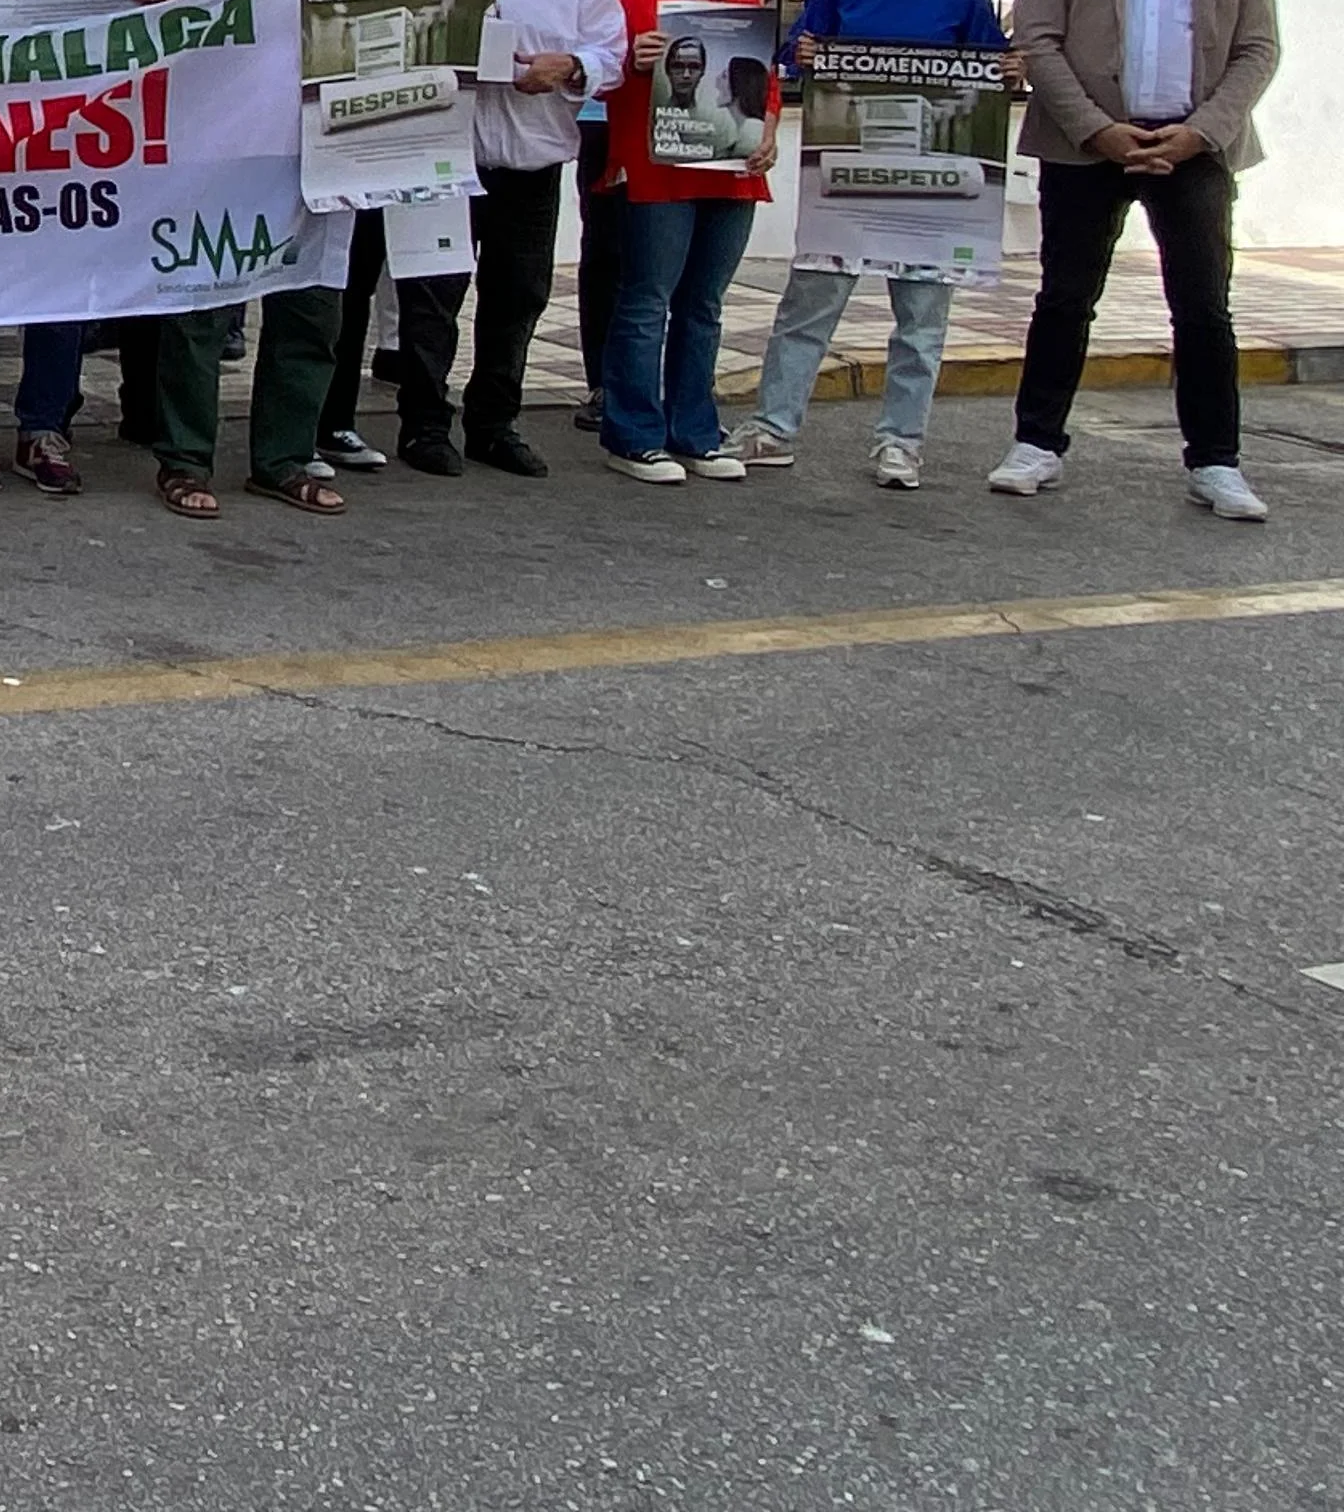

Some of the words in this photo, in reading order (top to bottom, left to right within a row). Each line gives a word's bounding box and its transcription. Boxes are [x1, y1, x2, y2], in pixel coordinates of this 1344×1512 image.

[814, 54, 1005, 81] RECOMENDADO
[330, 83, 438, 119] RESPETO
[656, 106, 689, 118] NADA
[831, 167, 960, 187] RESPETO
[151, 208, 274, 279] SMA
